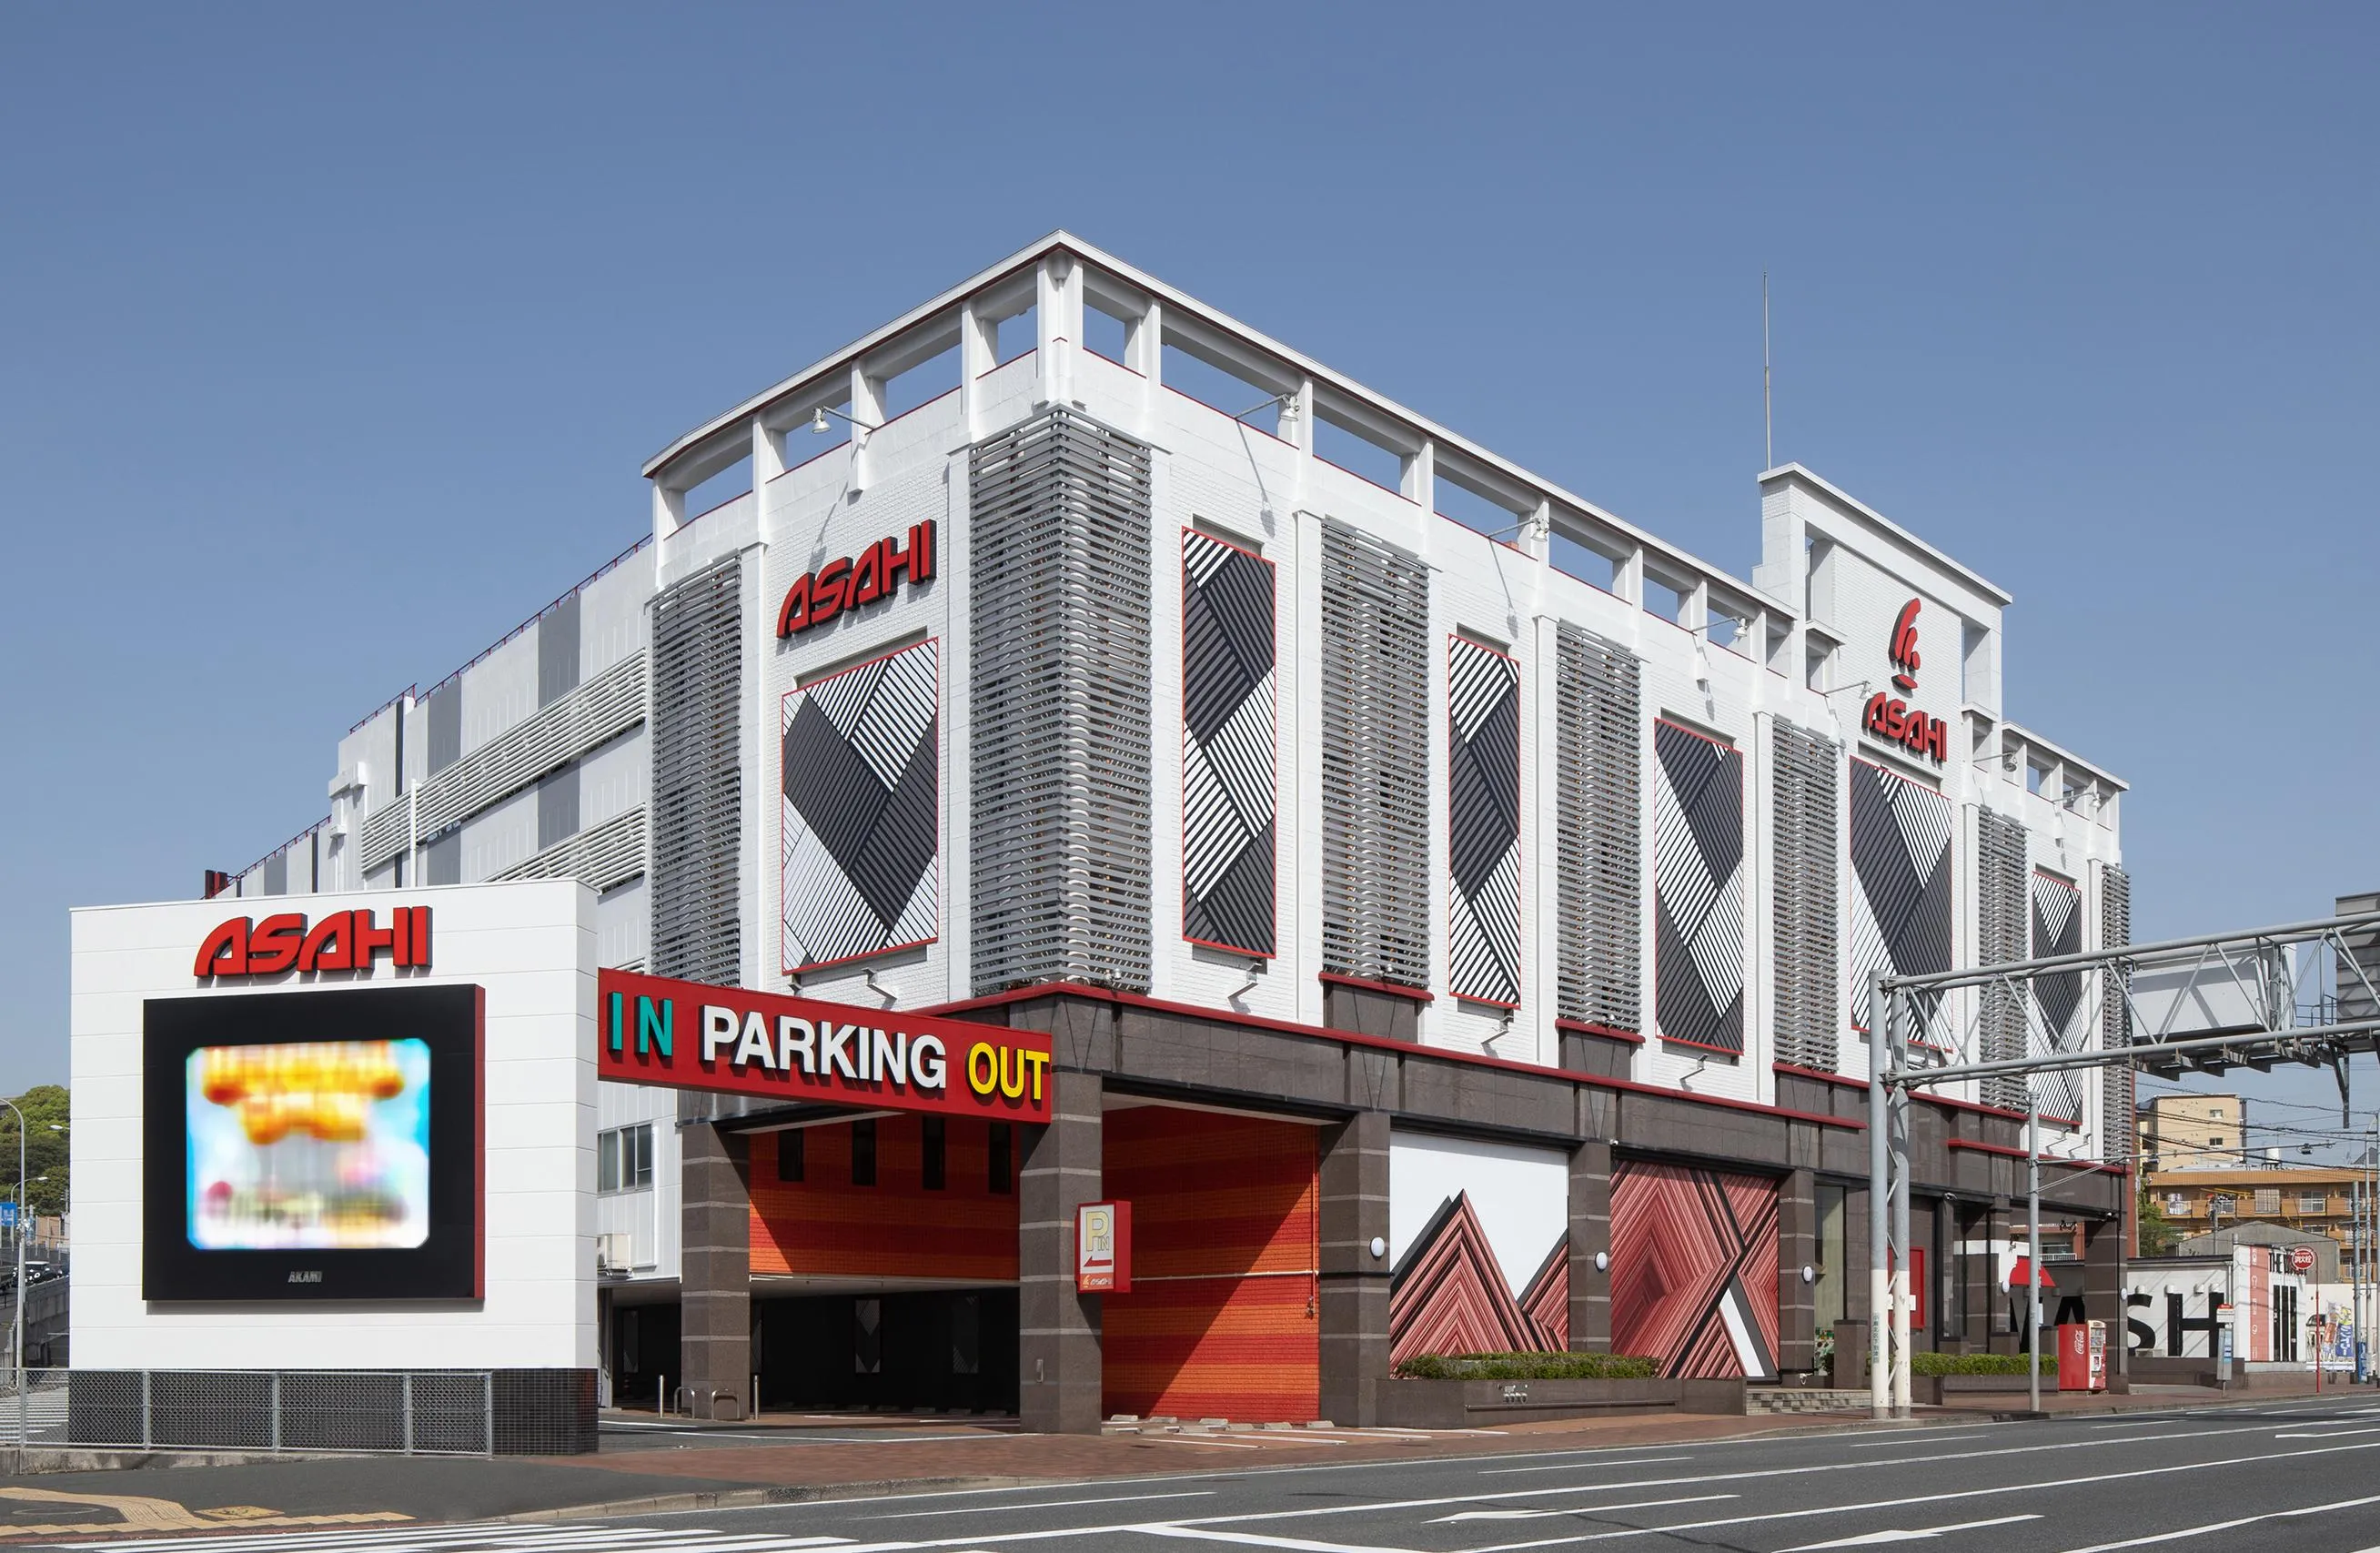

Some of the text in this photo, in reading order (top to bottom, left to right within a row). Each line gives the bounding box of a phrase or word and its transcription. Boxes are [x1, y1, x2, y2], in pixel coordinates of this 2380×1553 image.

[776, 519, 935, 640] ASAHI
[1862, 691, 1947, 762] ASAHI
[194, 906, 432, 976] ASAHI
[608, 992, 1050, 1101] IN PARKING OUT
[1085, 1210, 1110, 1252] P
[1098, 1236, 1110, 1251] IN
